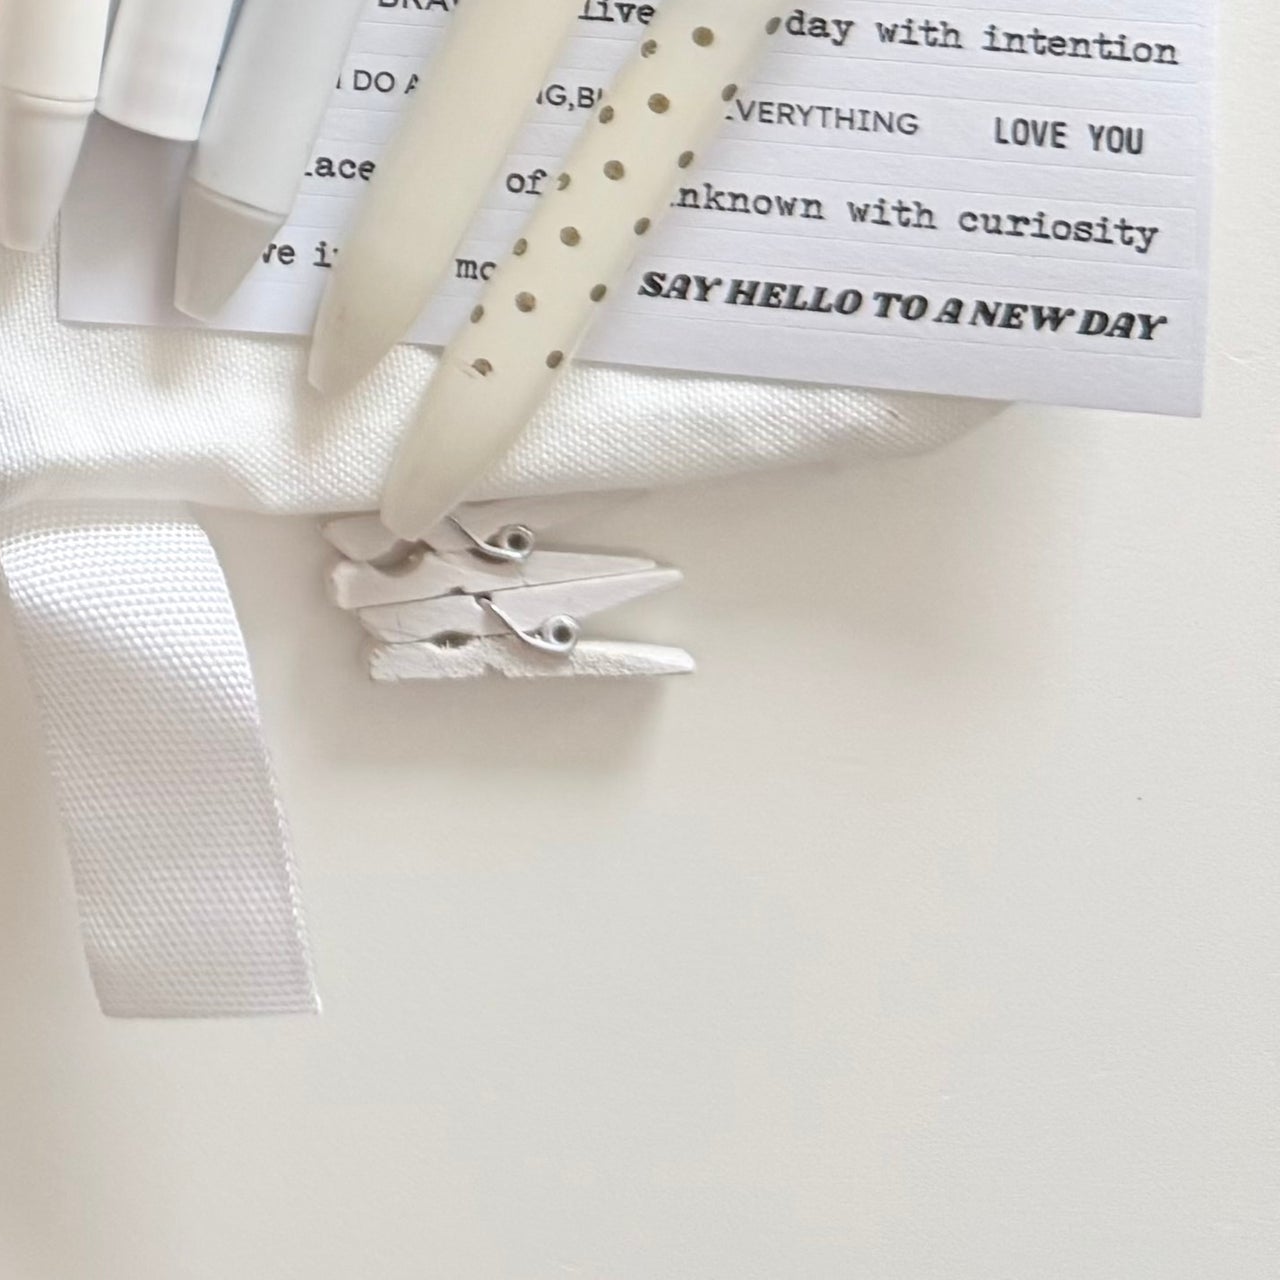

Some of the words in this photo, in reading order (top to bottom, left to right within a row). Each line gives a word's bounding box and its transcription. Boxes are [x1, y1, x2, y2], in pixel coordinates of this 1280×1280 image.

[785, 8, 855, 46] day
[874, 18, 962, 51] with
[981, 22, 1179, 66] intention
[352, 68, 396, 93] DO
[725, 100, 920, 136] VERYTHING
[993, 116, 1068, 149] LOVE
[1088, 124, 1145, 156] YOU
[505, 169, 549, 196] of
[669, 183, 825, 222] nknown
[846, 198, 938, 231] with
[957, 210, 1159, 254] curiosity
[638, 270, 723, 302] SAY
[724, 278, 862, 316] HELLO
[872, 290, 929, 321] TO
[933, 297, 965, 324] A
[969, 301, 1075, 333] NEW
[1076, 309, 1169, 340] DAY
